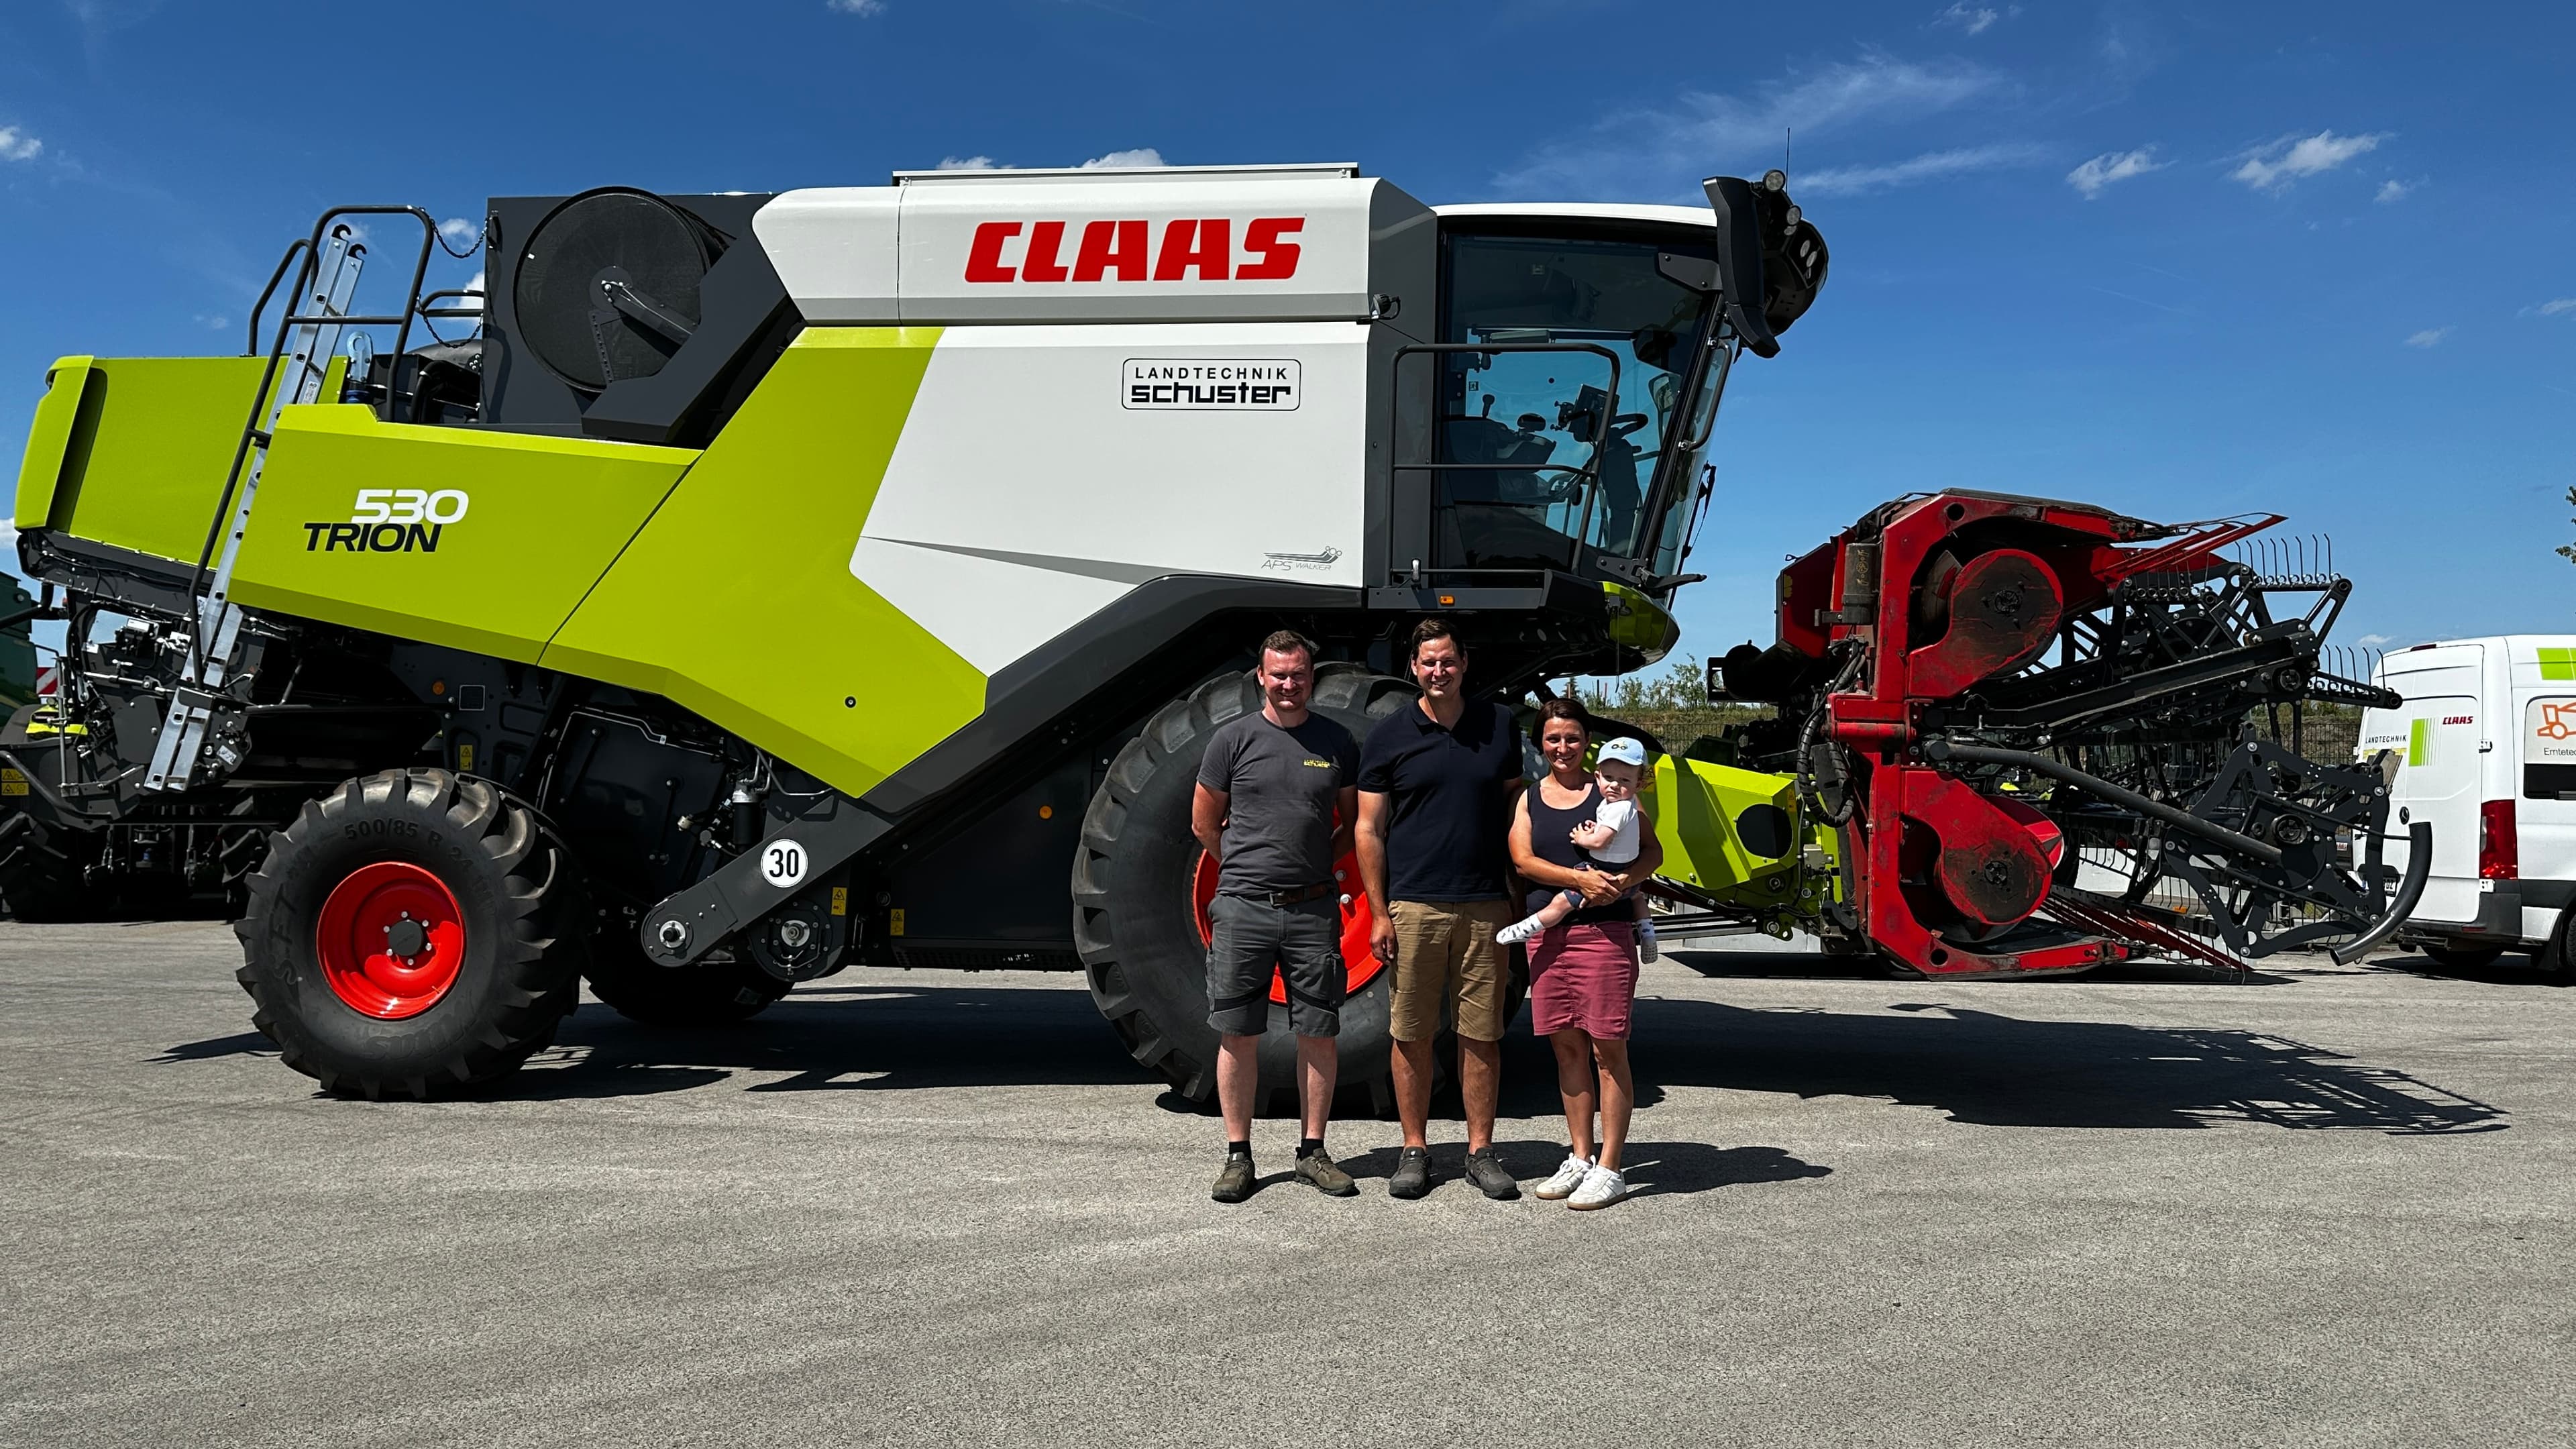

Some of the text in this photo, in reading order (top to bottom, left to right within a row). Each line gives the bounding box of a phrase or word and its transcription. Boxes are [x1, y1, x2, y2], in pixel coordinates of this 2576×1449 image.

[964, 217, 1305, 283] CLAAS
[1135, 367, 1287, 380] LANDTECHNIK
[1131, 382, 1291, 404] schuster
[350, 488, 470, 524] 530
[303, 523, 443, 552] TRION
[1261, 559, 1332, 571] APS WALKER
[2443, 716, 2473, 724] CLAAS
[2365, 735, 2406, 744] LANDTECHNIK
[344, 818, 419, 839] 500/85
[769, 849, 799, 877] 30
